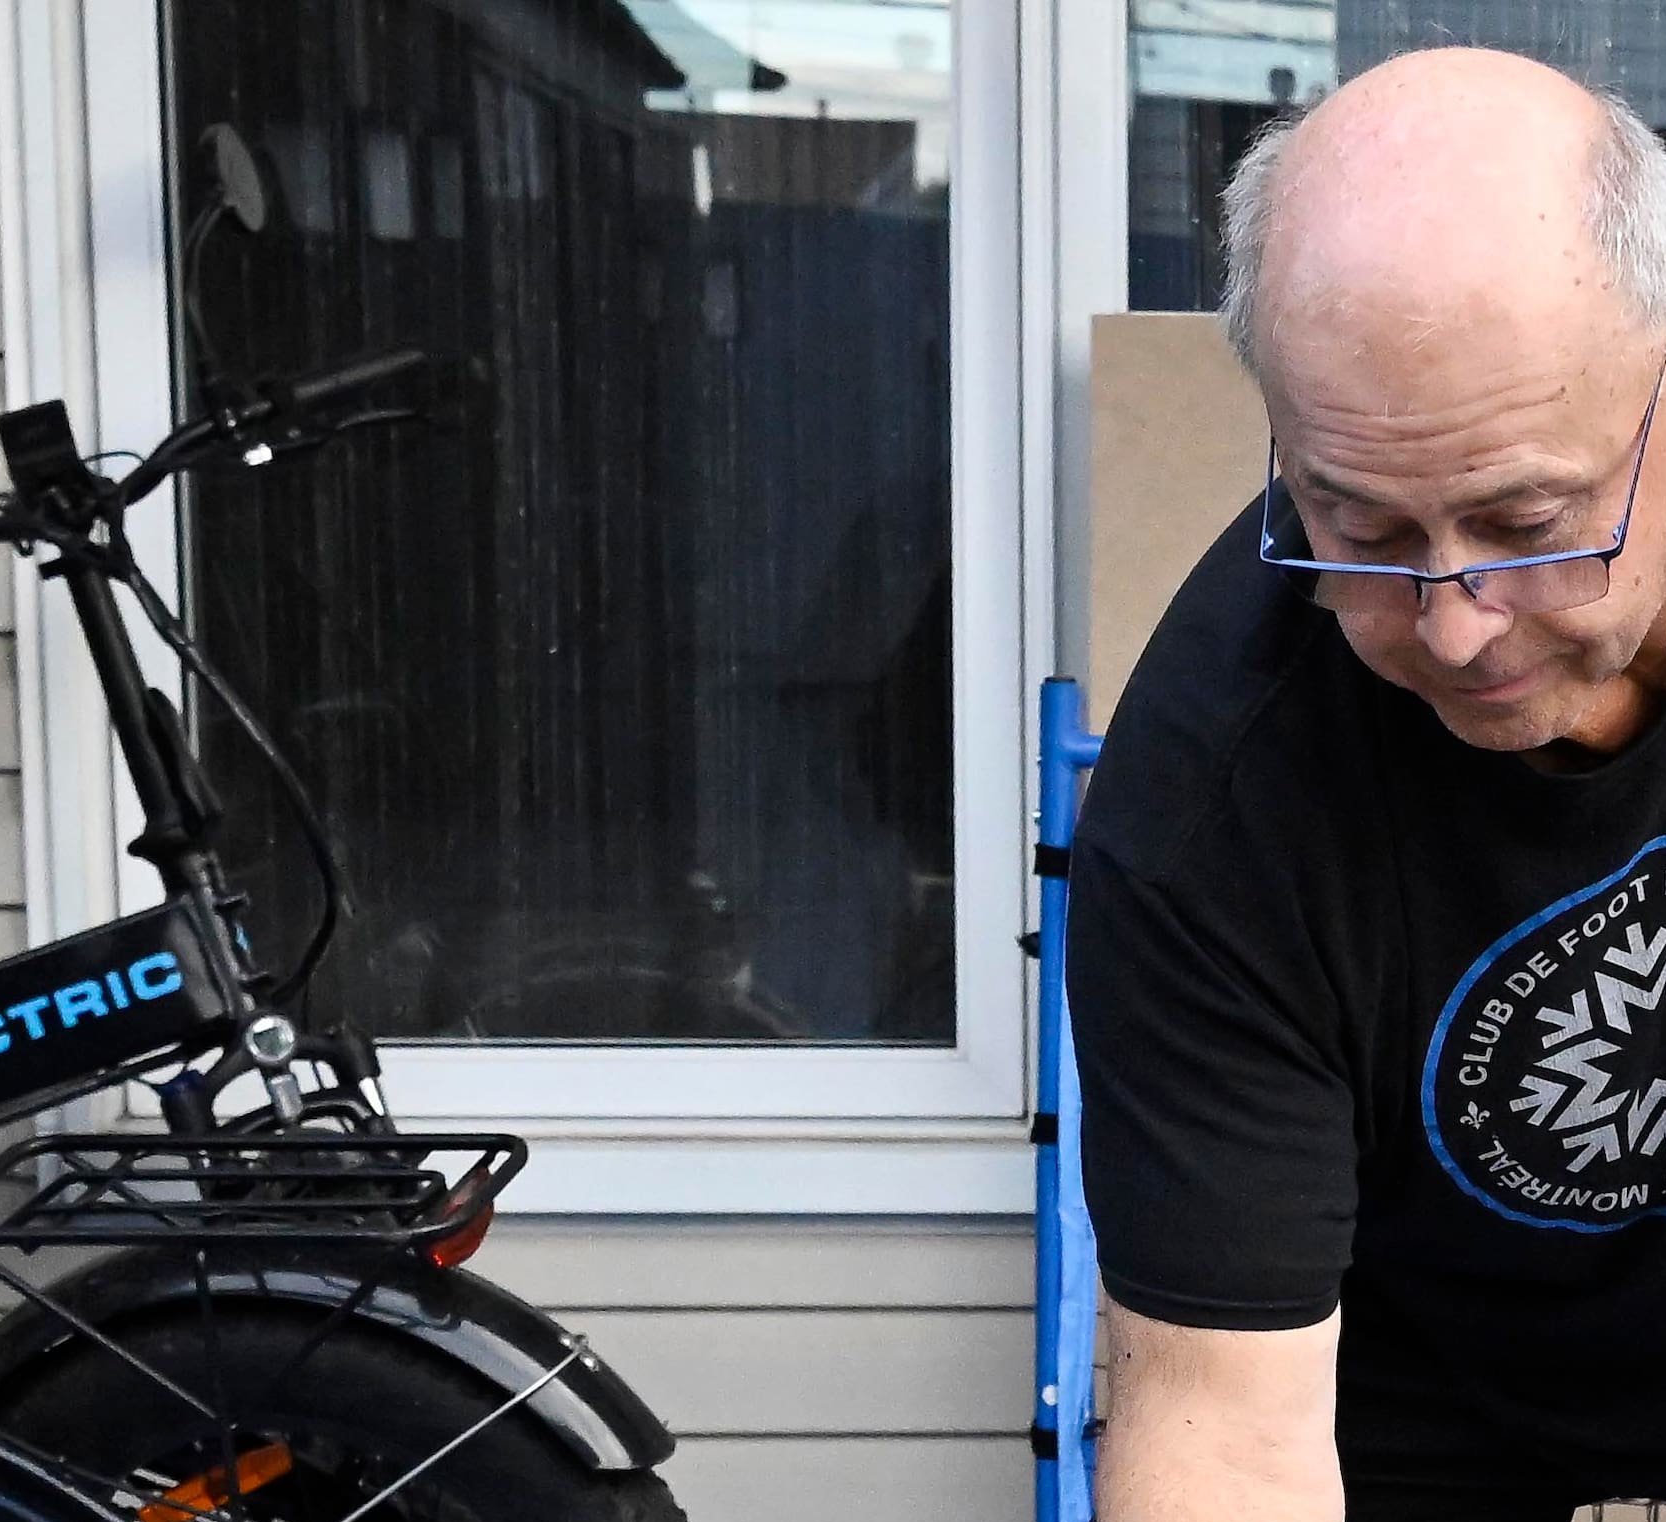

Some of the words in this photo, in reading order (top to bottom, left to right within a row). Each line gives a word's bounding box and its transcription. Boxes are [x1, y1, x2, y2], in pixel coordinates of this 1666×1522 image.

[1458, 998, 1514, 1087] CLUB
[1503, 951, 1559, 999] DE
[1557, 875, 1652, 957] FOOT
[1477, 1136, 1649, 1213] MONTRÉAL
